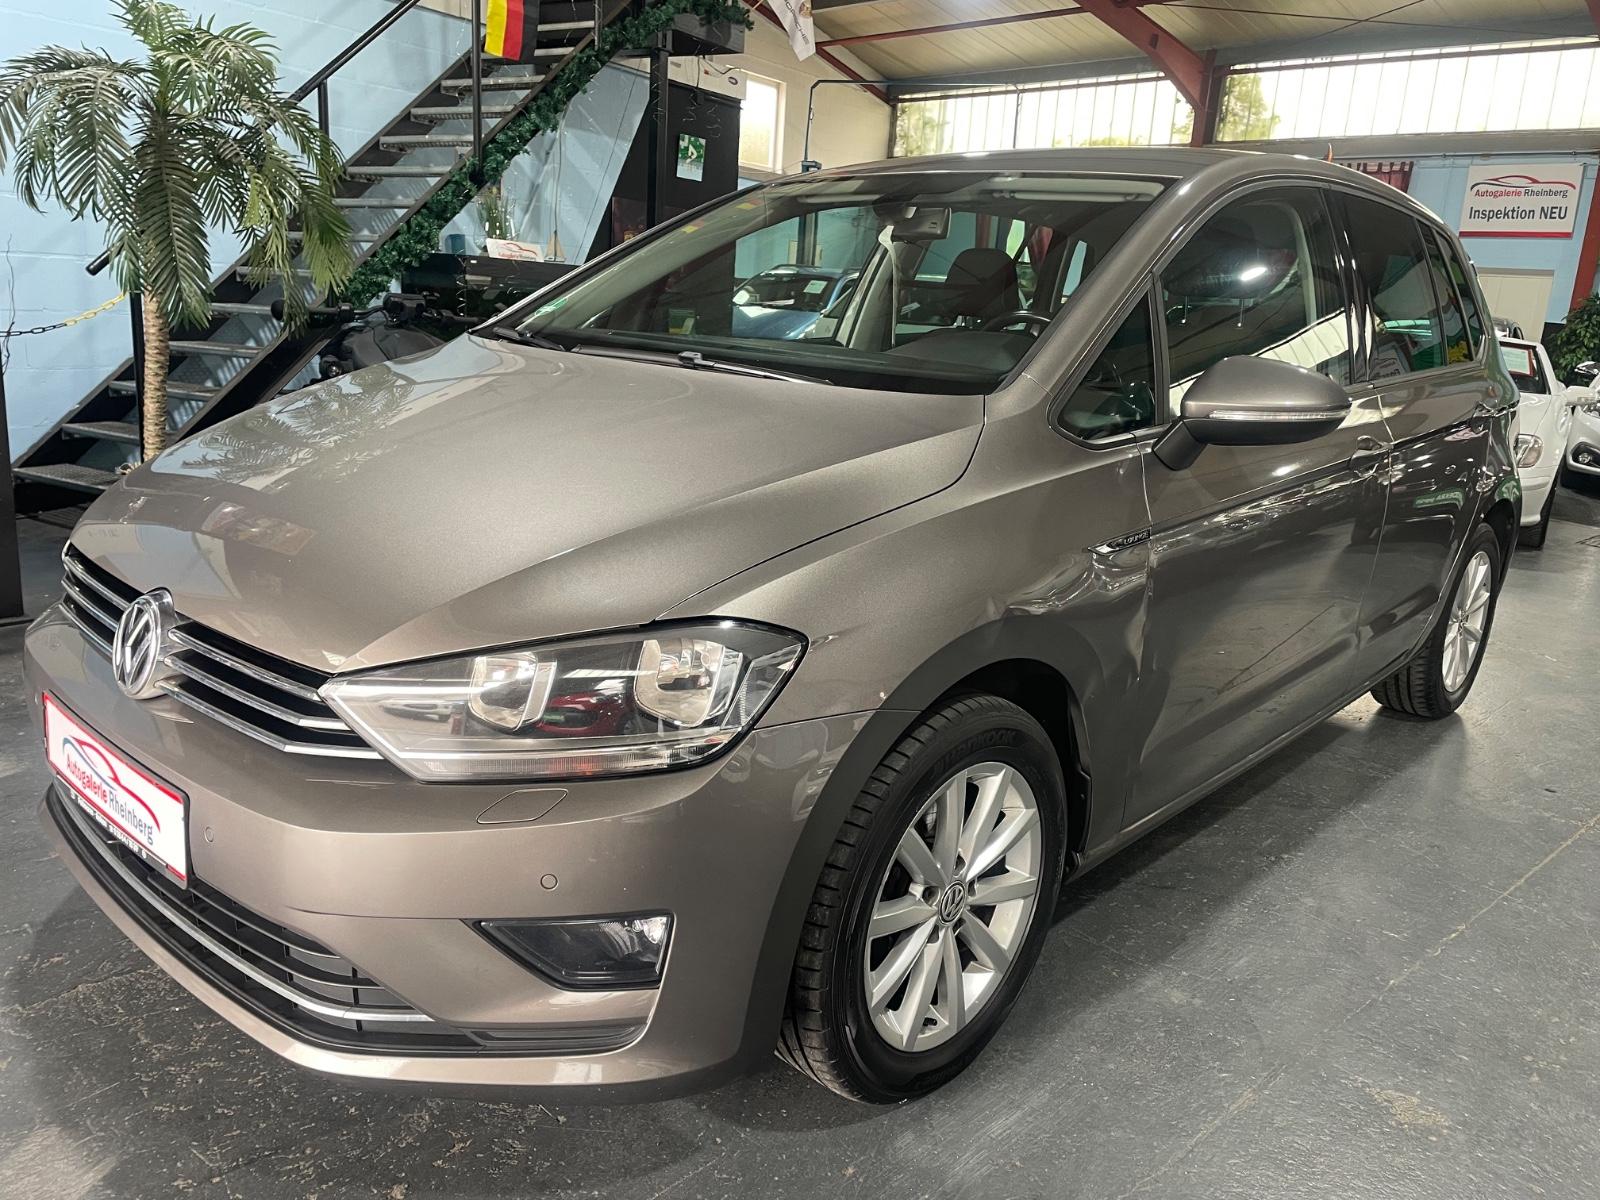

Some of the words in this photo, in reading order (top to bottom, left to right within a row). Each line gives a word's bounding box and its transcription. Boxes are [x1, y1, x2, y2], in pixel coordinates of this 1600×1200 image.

[1475, 188, 1522, 199] Autogalerie
[1523, 188, 1569, 198] Rheinberg
[1469, 206, 1535, 222] Inspektion
[1539, 206, 1568, 220] NEU
[66, 754, 108, 804] Autogalerie
[108, 789, 153, 846] Rheinberg
